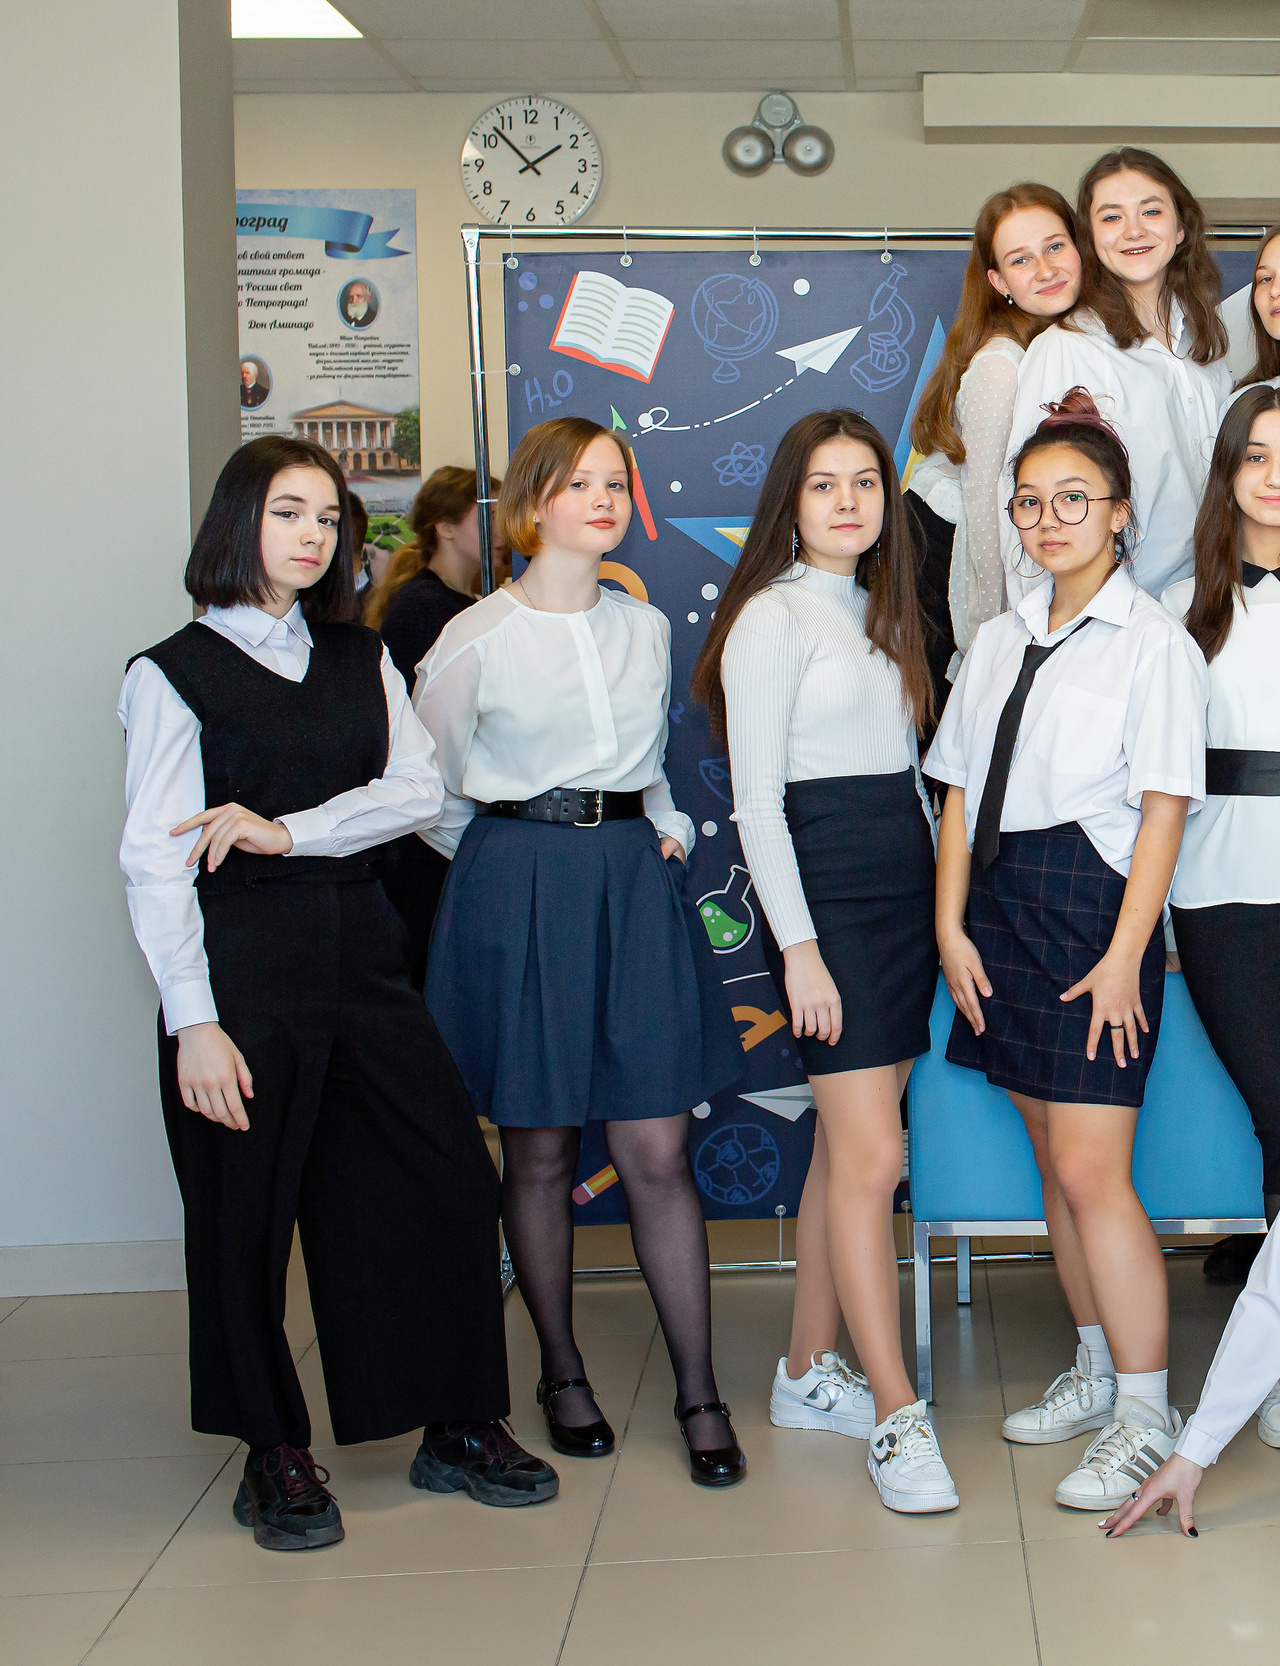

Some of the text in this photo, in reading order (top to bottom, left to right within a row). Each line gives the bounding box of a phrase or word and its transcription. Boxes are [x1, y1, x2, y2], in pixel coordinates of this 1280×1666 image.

[500, 116, 513, 130] 11
[523, 109, 538, 124] 12
[553, 116, 559, 131] 1
[482, 133, 498, 149] 10
[569, 134, 579, 149] 2
[474, 158, 485, 173] 9
[577, 158, 587, 173] 3
[482, 180, 492, 195] 8
[569, 181, 580, 195] 4
[500, 200, 510, 215] 7
[525, 207, 536, 222] 6
[554, 200, 565, 215] 5
[250, 250, 270, 260] свой
[272, 251, 304, 260] ответ
[279, 268, 321, 277] громада
[245, 282, 277, 291] России
[280, 281, 303, 291] свет
[245, 298, 308, 309] Петрограда!
[248, 319, 314, 331] Дон Аминадо
[525, 370, 573, 413] H2O
